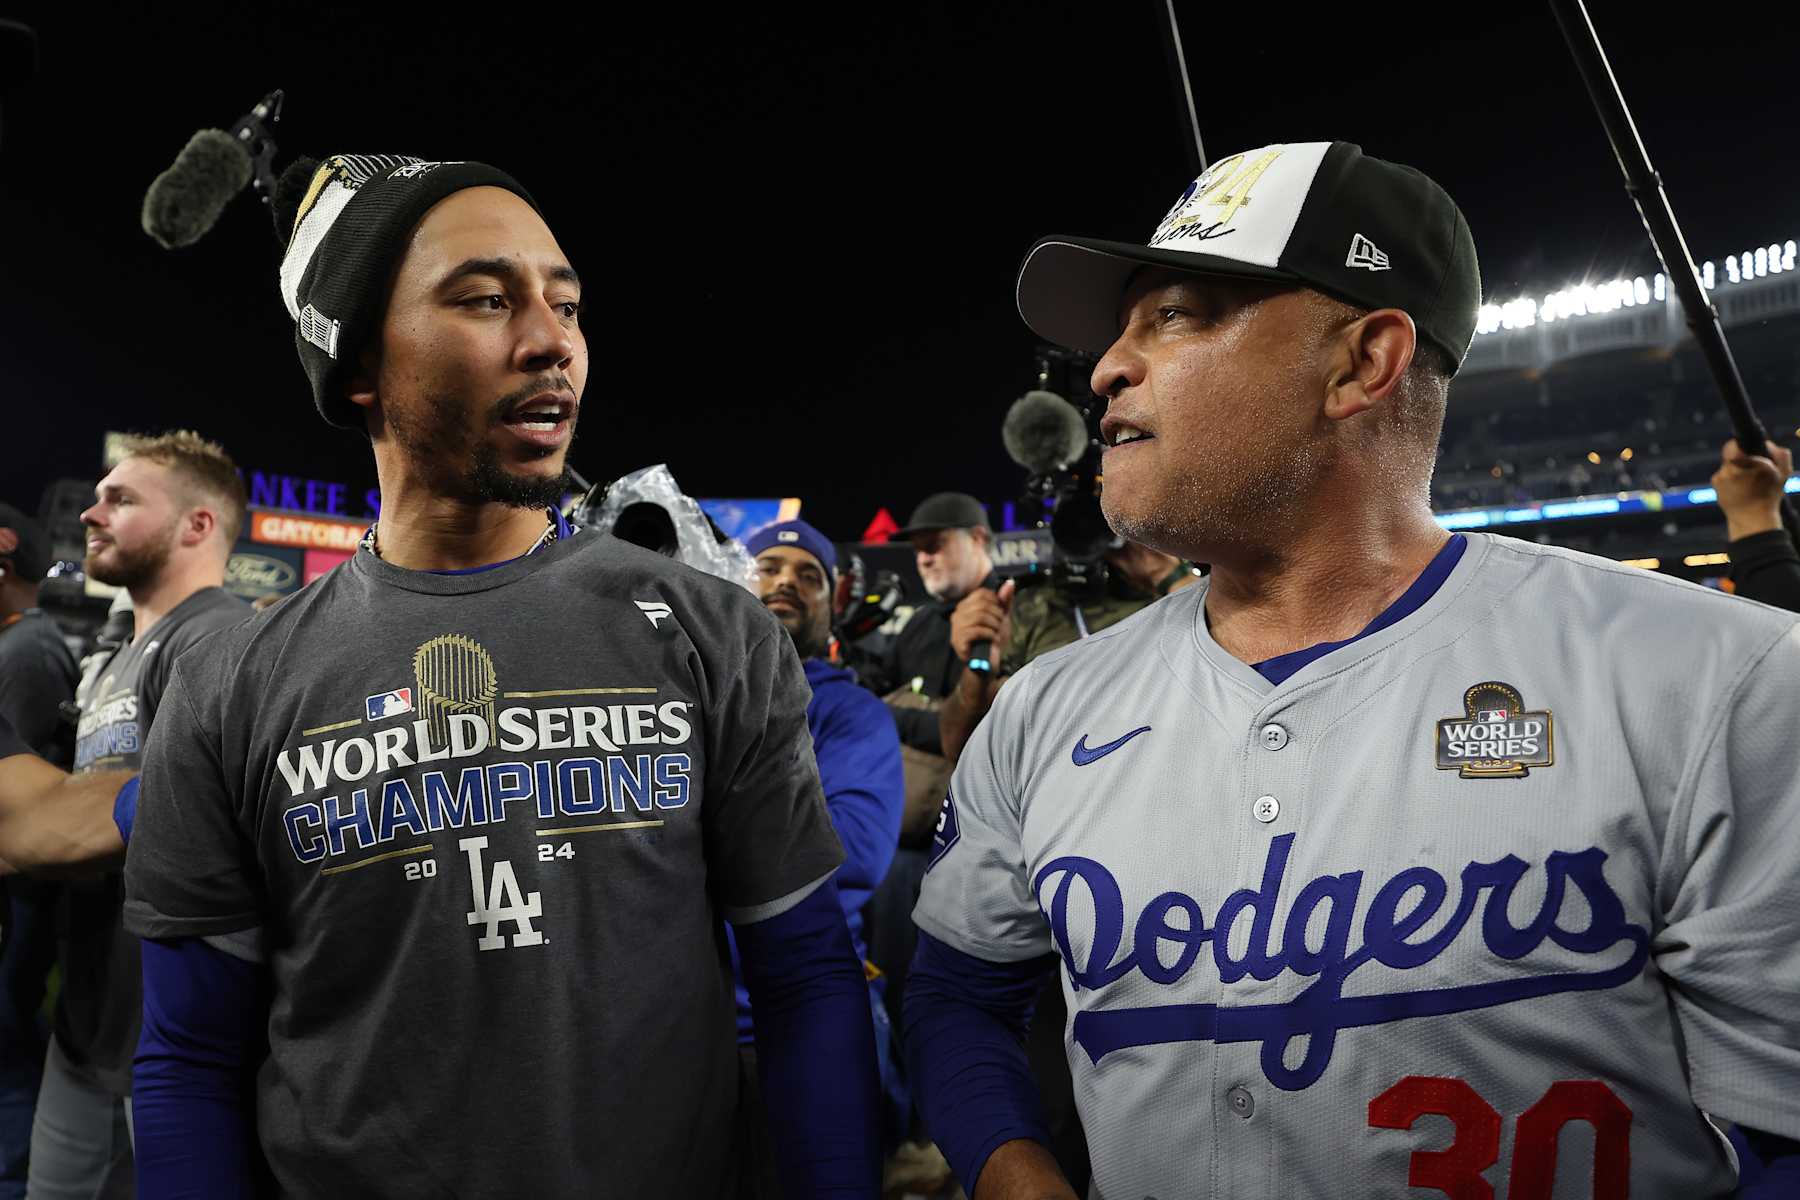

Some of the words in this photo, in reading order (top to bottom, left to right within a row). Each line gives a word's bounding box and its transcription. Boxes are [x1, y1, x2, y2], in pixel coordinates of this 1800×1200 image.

[261, 516, 362, 548] GATORA
[277, 712, 490, 796] WORLD
[498, 701, 692, 753] SERIES
[1444, 721, 1542, 741] WORLD
[1447, 738, 1539, 759] SERIES
[283, 753, 691, 864] CHAMPIONS
[404, 858, 438, 881] 20
[538, 841, 576, 862] 24
[459, 836, 544, 951] LA
[1035, 832, 1650, 1092] Dodgers
[1368, 1075, 1633, 1200] 30
